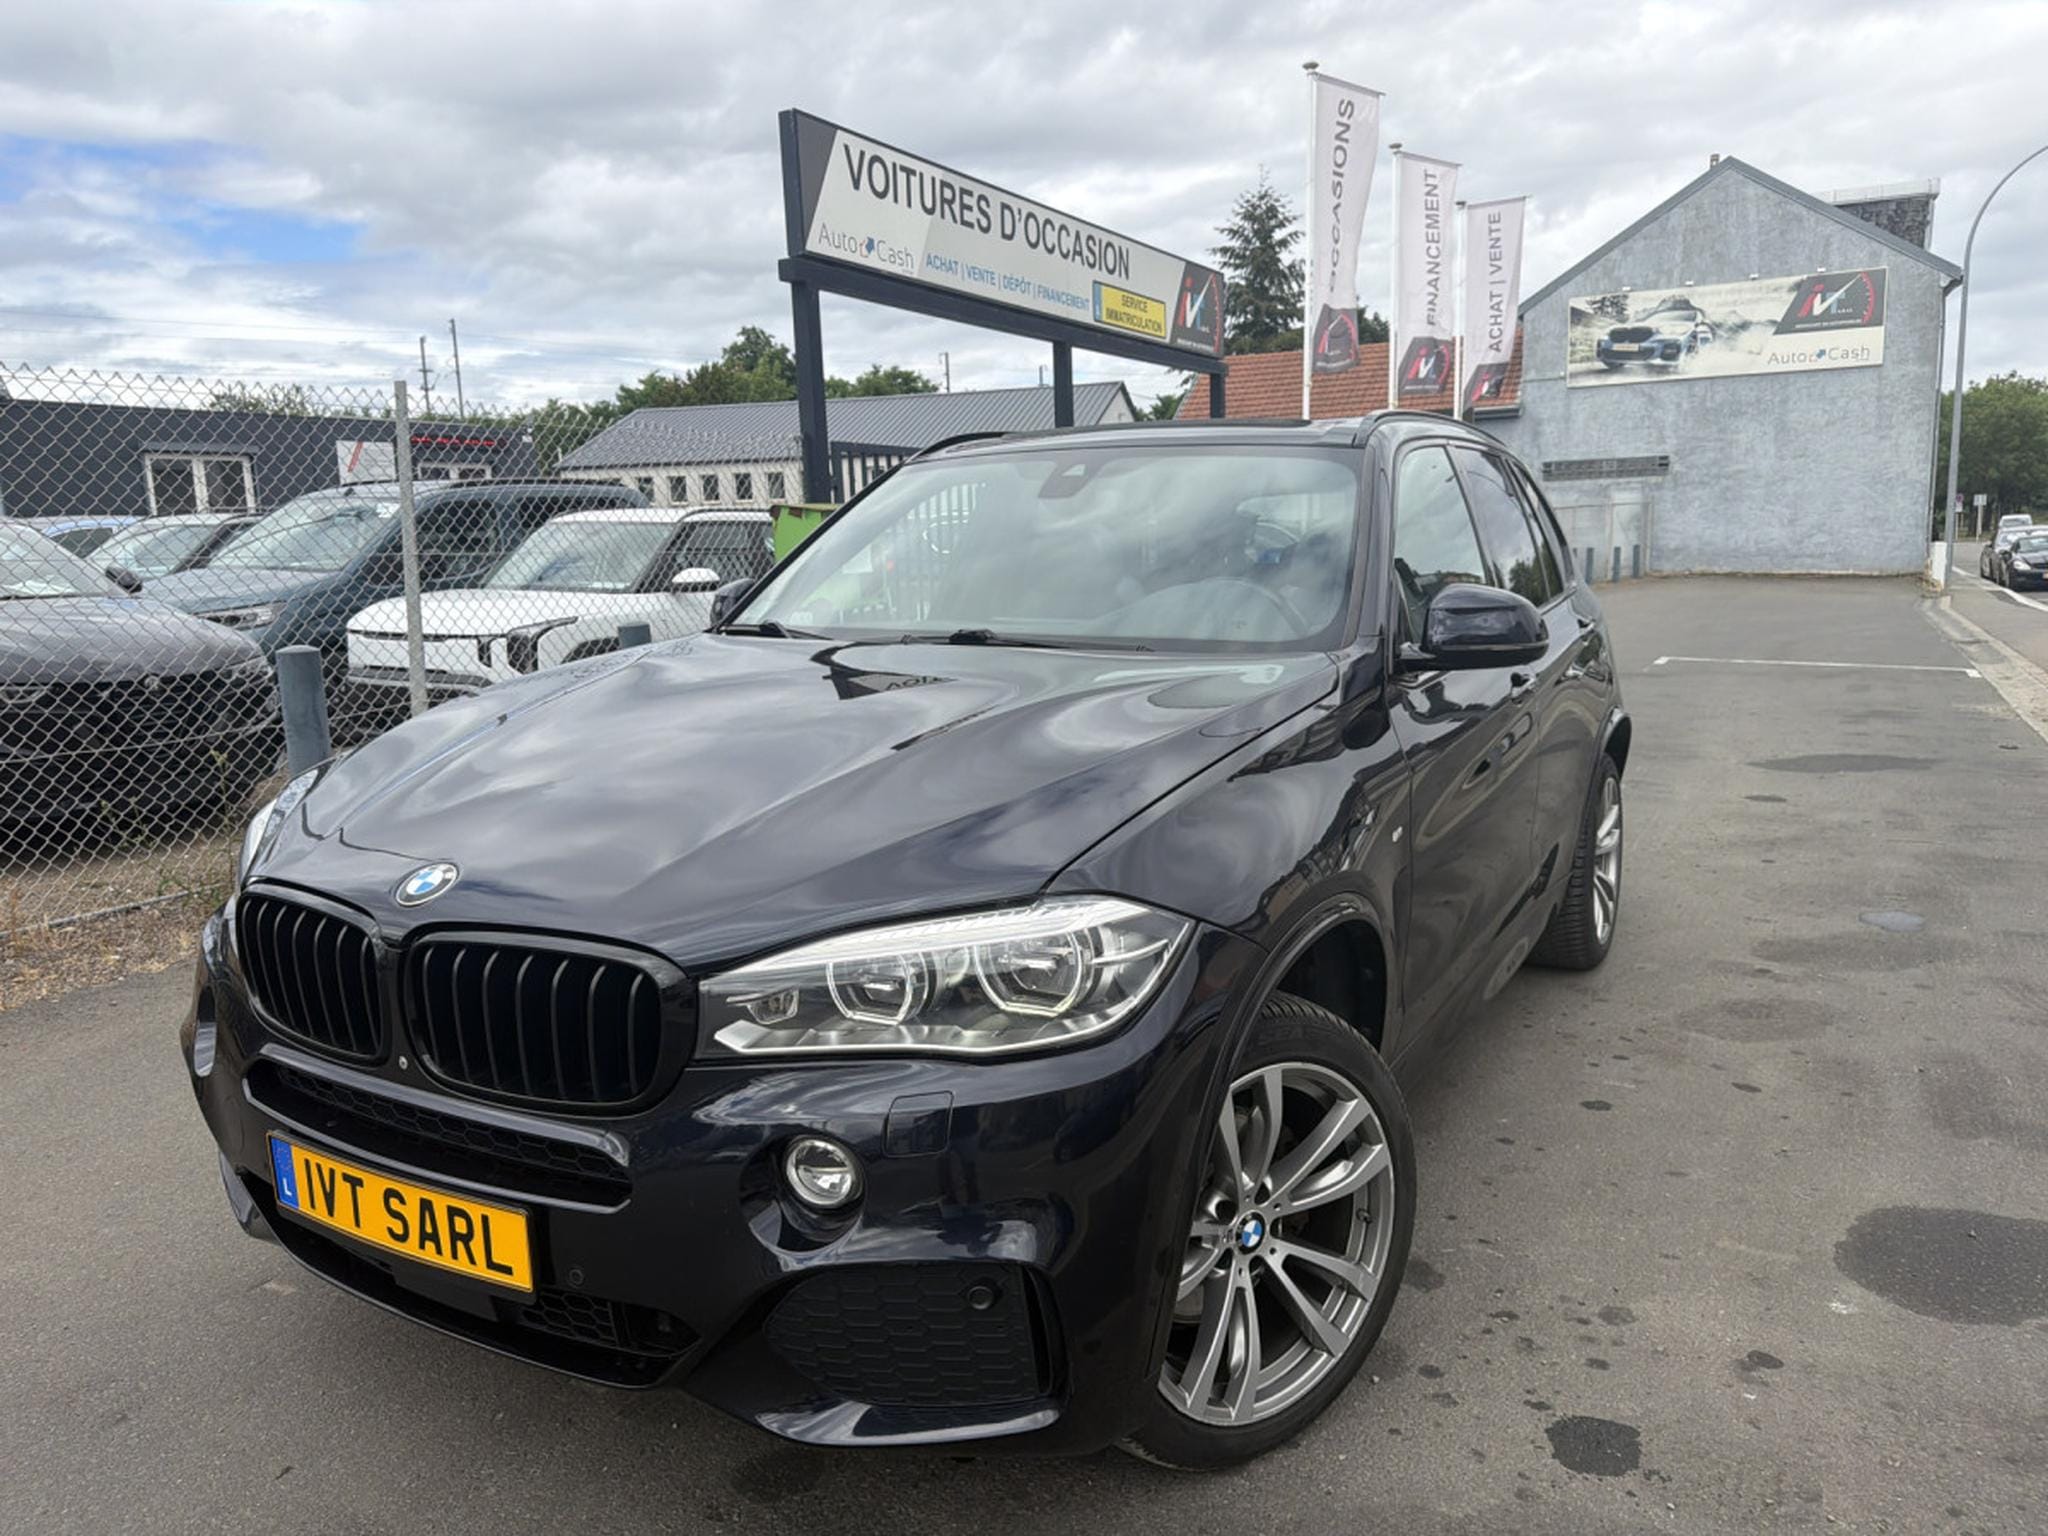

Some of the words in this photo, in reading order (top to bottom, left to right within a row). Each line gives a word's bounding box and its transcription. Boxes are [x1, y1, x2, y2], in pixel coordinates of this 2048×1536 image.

[843, 143, 992, 235] VOITURES
[1000, 201, 1130, 281] D'OCCASION
[818, 221, 858, 254] Auto
[876, 239, 915, 270] Cash
[1423, 168, 1442, 327] FINANCEMENT
[1487, 211, 1502, 276] VENTE
[926, 252, 959, 276] ACHAT
[966, 264, 997, 287] VENTE
[1037, 284, 1090, 312] FINANCEMENT
[1121, 294, 1148, 313] SERVICE
[1488, 290, 1502, 353] ACHAT
[1767, 351, 1808, 366] Auto
[1828, 345, 1871, 361] Cash
[282, 1177, 293, 1197] L
[303, 1158, 365, 1229] IVT
[382, 1187, 514, 1277] SARL
